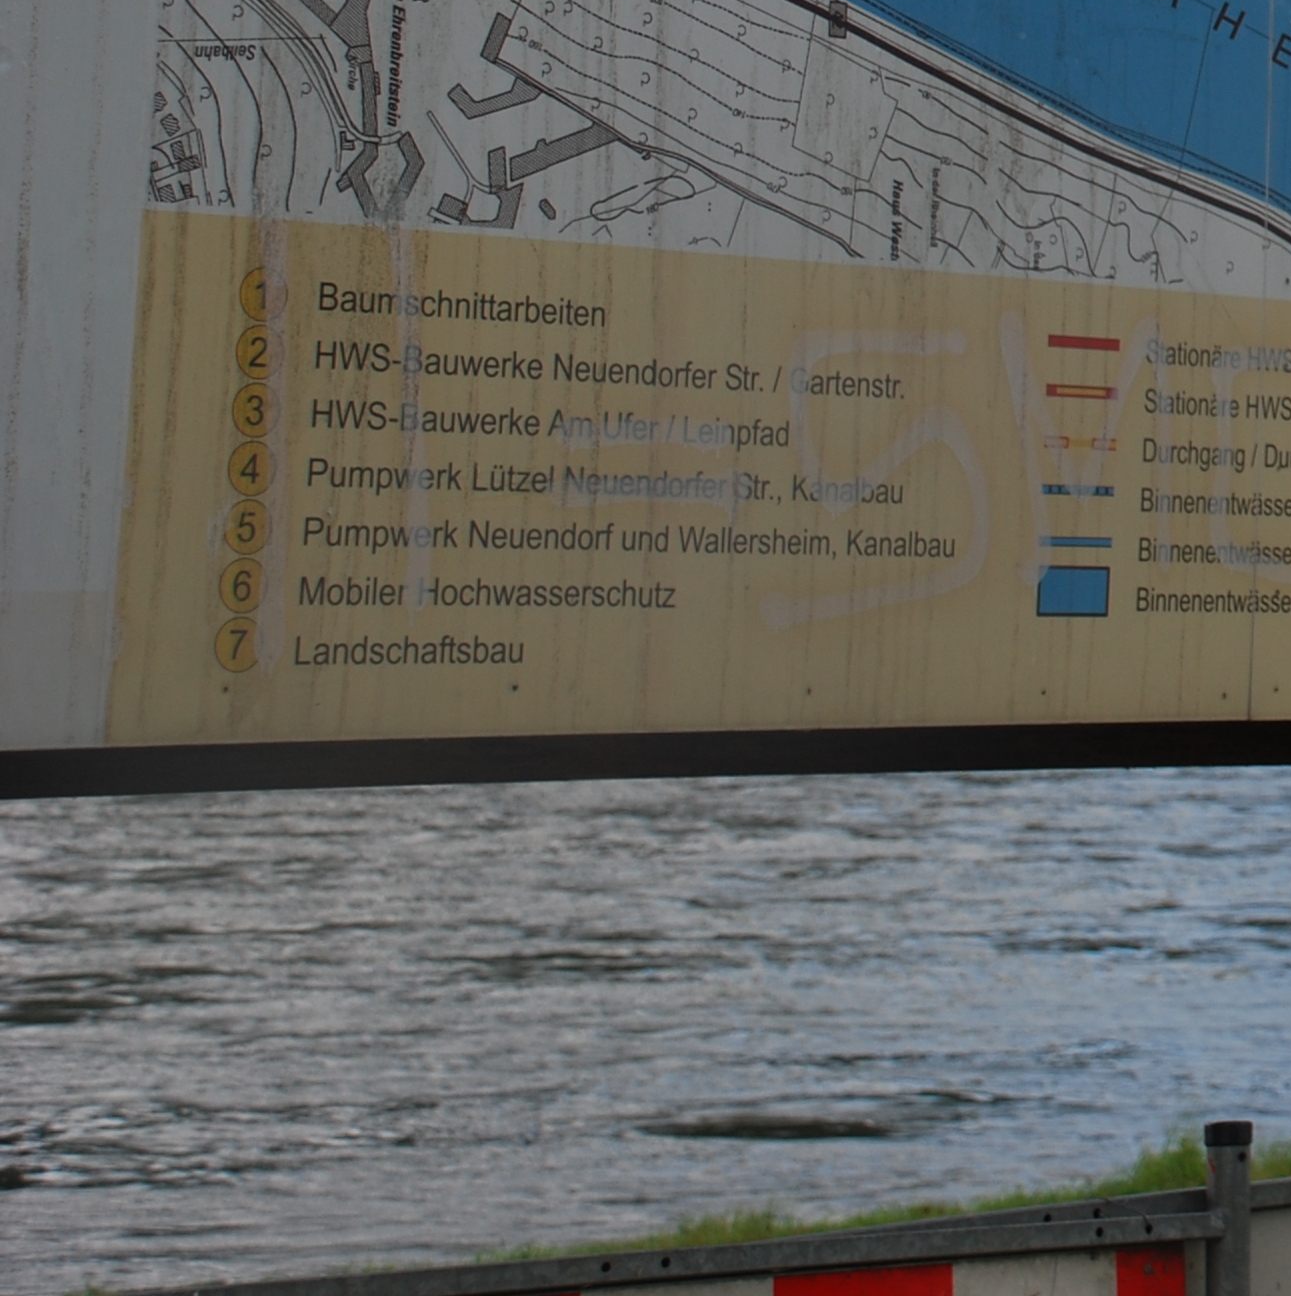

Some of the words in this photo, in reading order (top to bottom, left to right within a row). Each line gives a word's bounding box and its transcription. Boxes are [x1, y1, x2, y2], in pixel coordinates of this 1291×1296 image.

[255, 281, 269, 310] 1
[317, 281, 607, 328] Baumschnittarbeiten
[249, 337, 268, 369] 2
[1145, 339, 1241, 370] Stationäre
[314, 340, 544, 380] HWS-Bauwerke
[553, 352, 718, 390] Neuendorfer
[725, 362, 765, 392] Str.
[771, 365, 783, 394] /
[790, 366, 906, 400] Gartenstr.
[245, 394, 265, 427] 3
[1143, 387, 1241, 419] Stationäre
[311, 398, 541, 437] HWS-Bauwerke
[547, 409, 595, 439] Am
[602, 411, 661, 441] Ufer
[665, 414, 677, 442] /
[682, 415, 790, 452] Leinpfad
[239, 453, 260, 484] 4
[1142, 437, 1246, 474] Durchgang
[1250, 444, 1259, 468] /
[307, 457, 463, 496] Pumpwerk
[471, 461, 555, 494] Lützel
[563, 464, 729, 501] Neuendorfer
[734, 471, 783, 504] Str.,
[792, 473, 905, 505] Kanalbau
[236, 511, 257, 544] 5
[303, 516, 459, 555] Pumpwerk
[468, 520, 615, 551] Neuendorf
[620, 525, 670, 553] und
[678, 525, 838, 561] Wallersheim,
[845, 529, 957, 558] Kanalbau
[232, 570, 253, 602] 6
[299, 575, 409, 606] Mobiler
[418, 577, 678, 609] Hochwasserschutz
[228, 629, 249, 661] 7
[293, 635, 525, 666] Landschaftsbau
